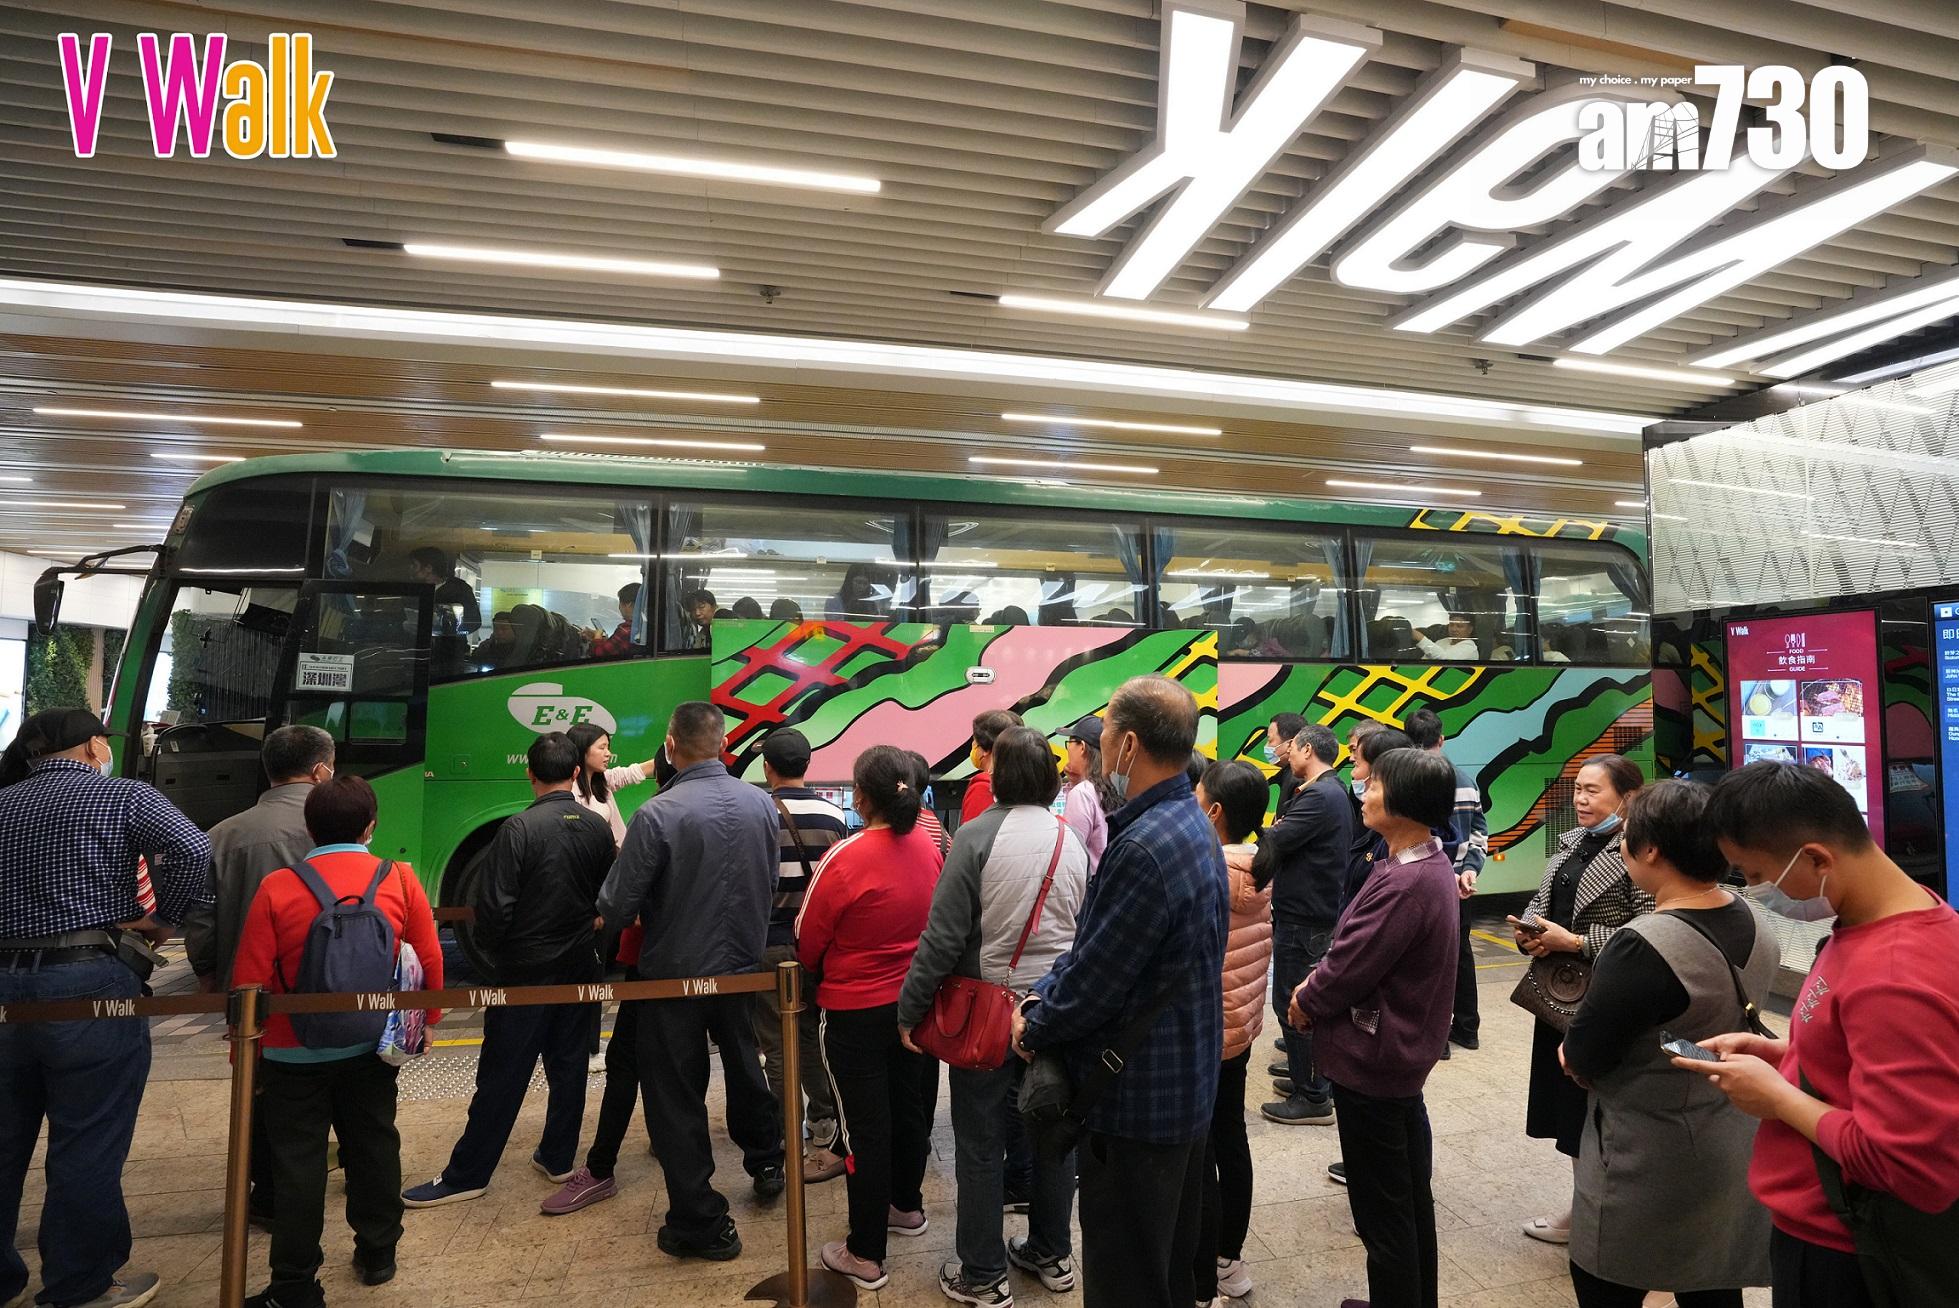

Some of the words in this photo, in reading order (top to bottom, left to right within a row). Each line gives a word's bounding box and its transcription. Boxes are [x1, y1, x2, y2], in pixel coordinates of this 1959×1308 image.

[1778, 654, 1815, 665] 飲食指南
[303, 671, 347, 687] 深圳灣
[578, 985, 585, 1001] V
[588, 984, 614, 1000] Walk
[683, 980, 691, 995] V
[692, 978, 718, 994] Walk
[356, 994, 364, 1010] V
[368, 992, 396, 1010] Walk
[469, 990, 477, 1006] V
[480, 989, 507, 1005] Walk
[93, 1001, 101, 1017] V
[106, 999, 136, 1016] Walk
